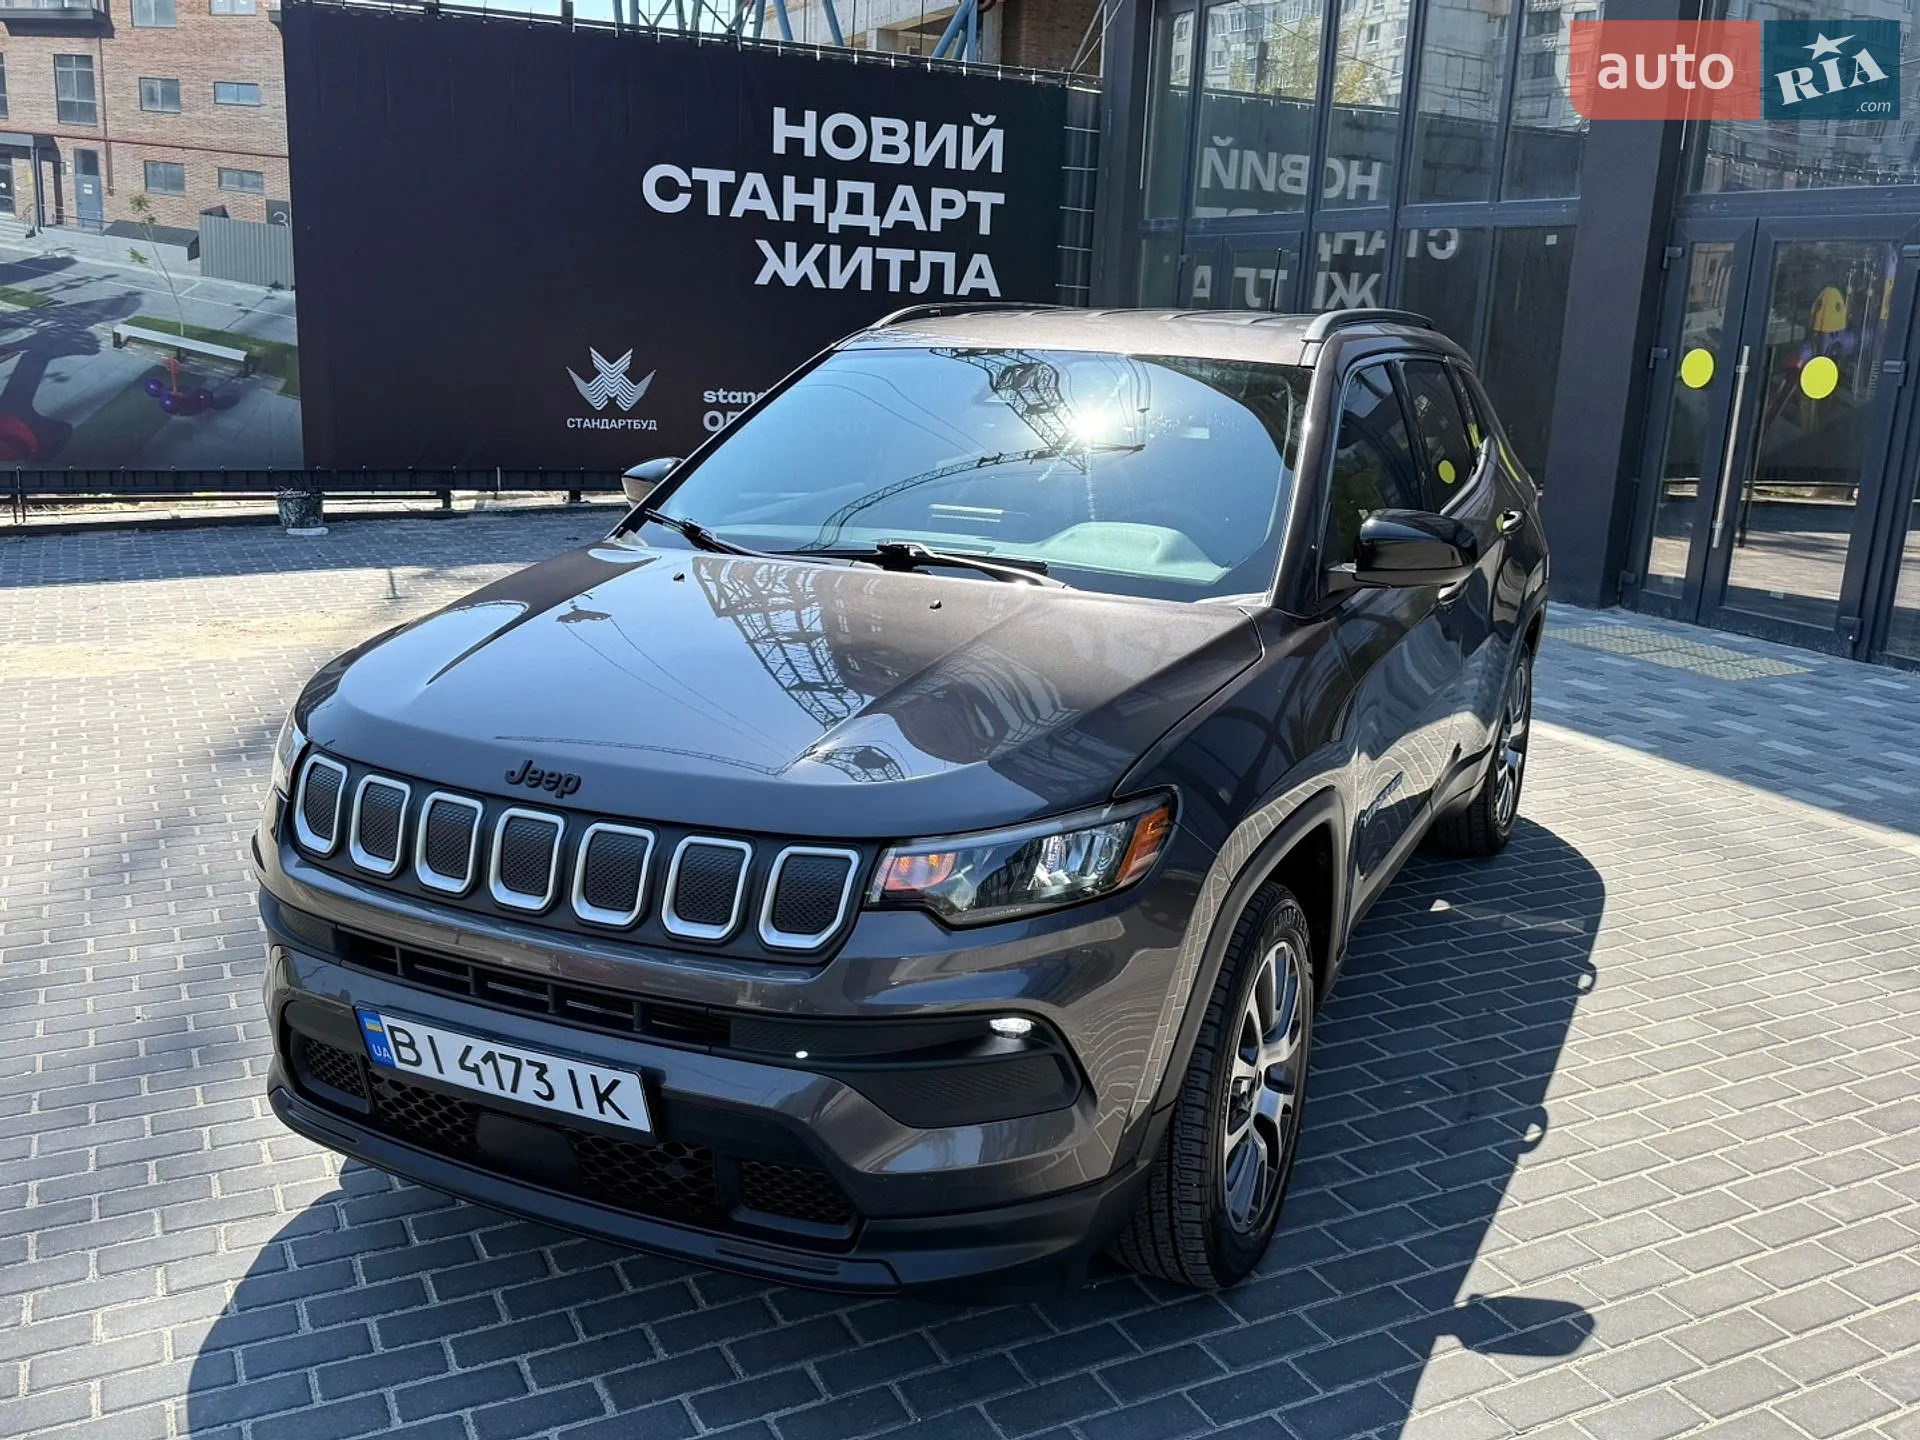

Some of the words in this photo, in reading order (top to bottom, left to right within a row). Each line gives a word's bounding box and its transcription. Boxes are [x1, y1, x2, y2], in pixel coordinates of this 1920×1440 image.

[772, 106, 1004, 173] НОВИЙ
[641, 163, 1006, 237] СТАНДАРТ
[753, 239, 1002, 298] ЖИТЛА
[566, 417, 658, 431] СТАНДАРТБУД
[504, 759, 582, 800] Jeep
[371, 1043, 392, 1060] UA
[386, 1023, 445, 1075] BI
[458, 1044, 555, 1102] 4173
[567, 1067, 631, 1122] IK
